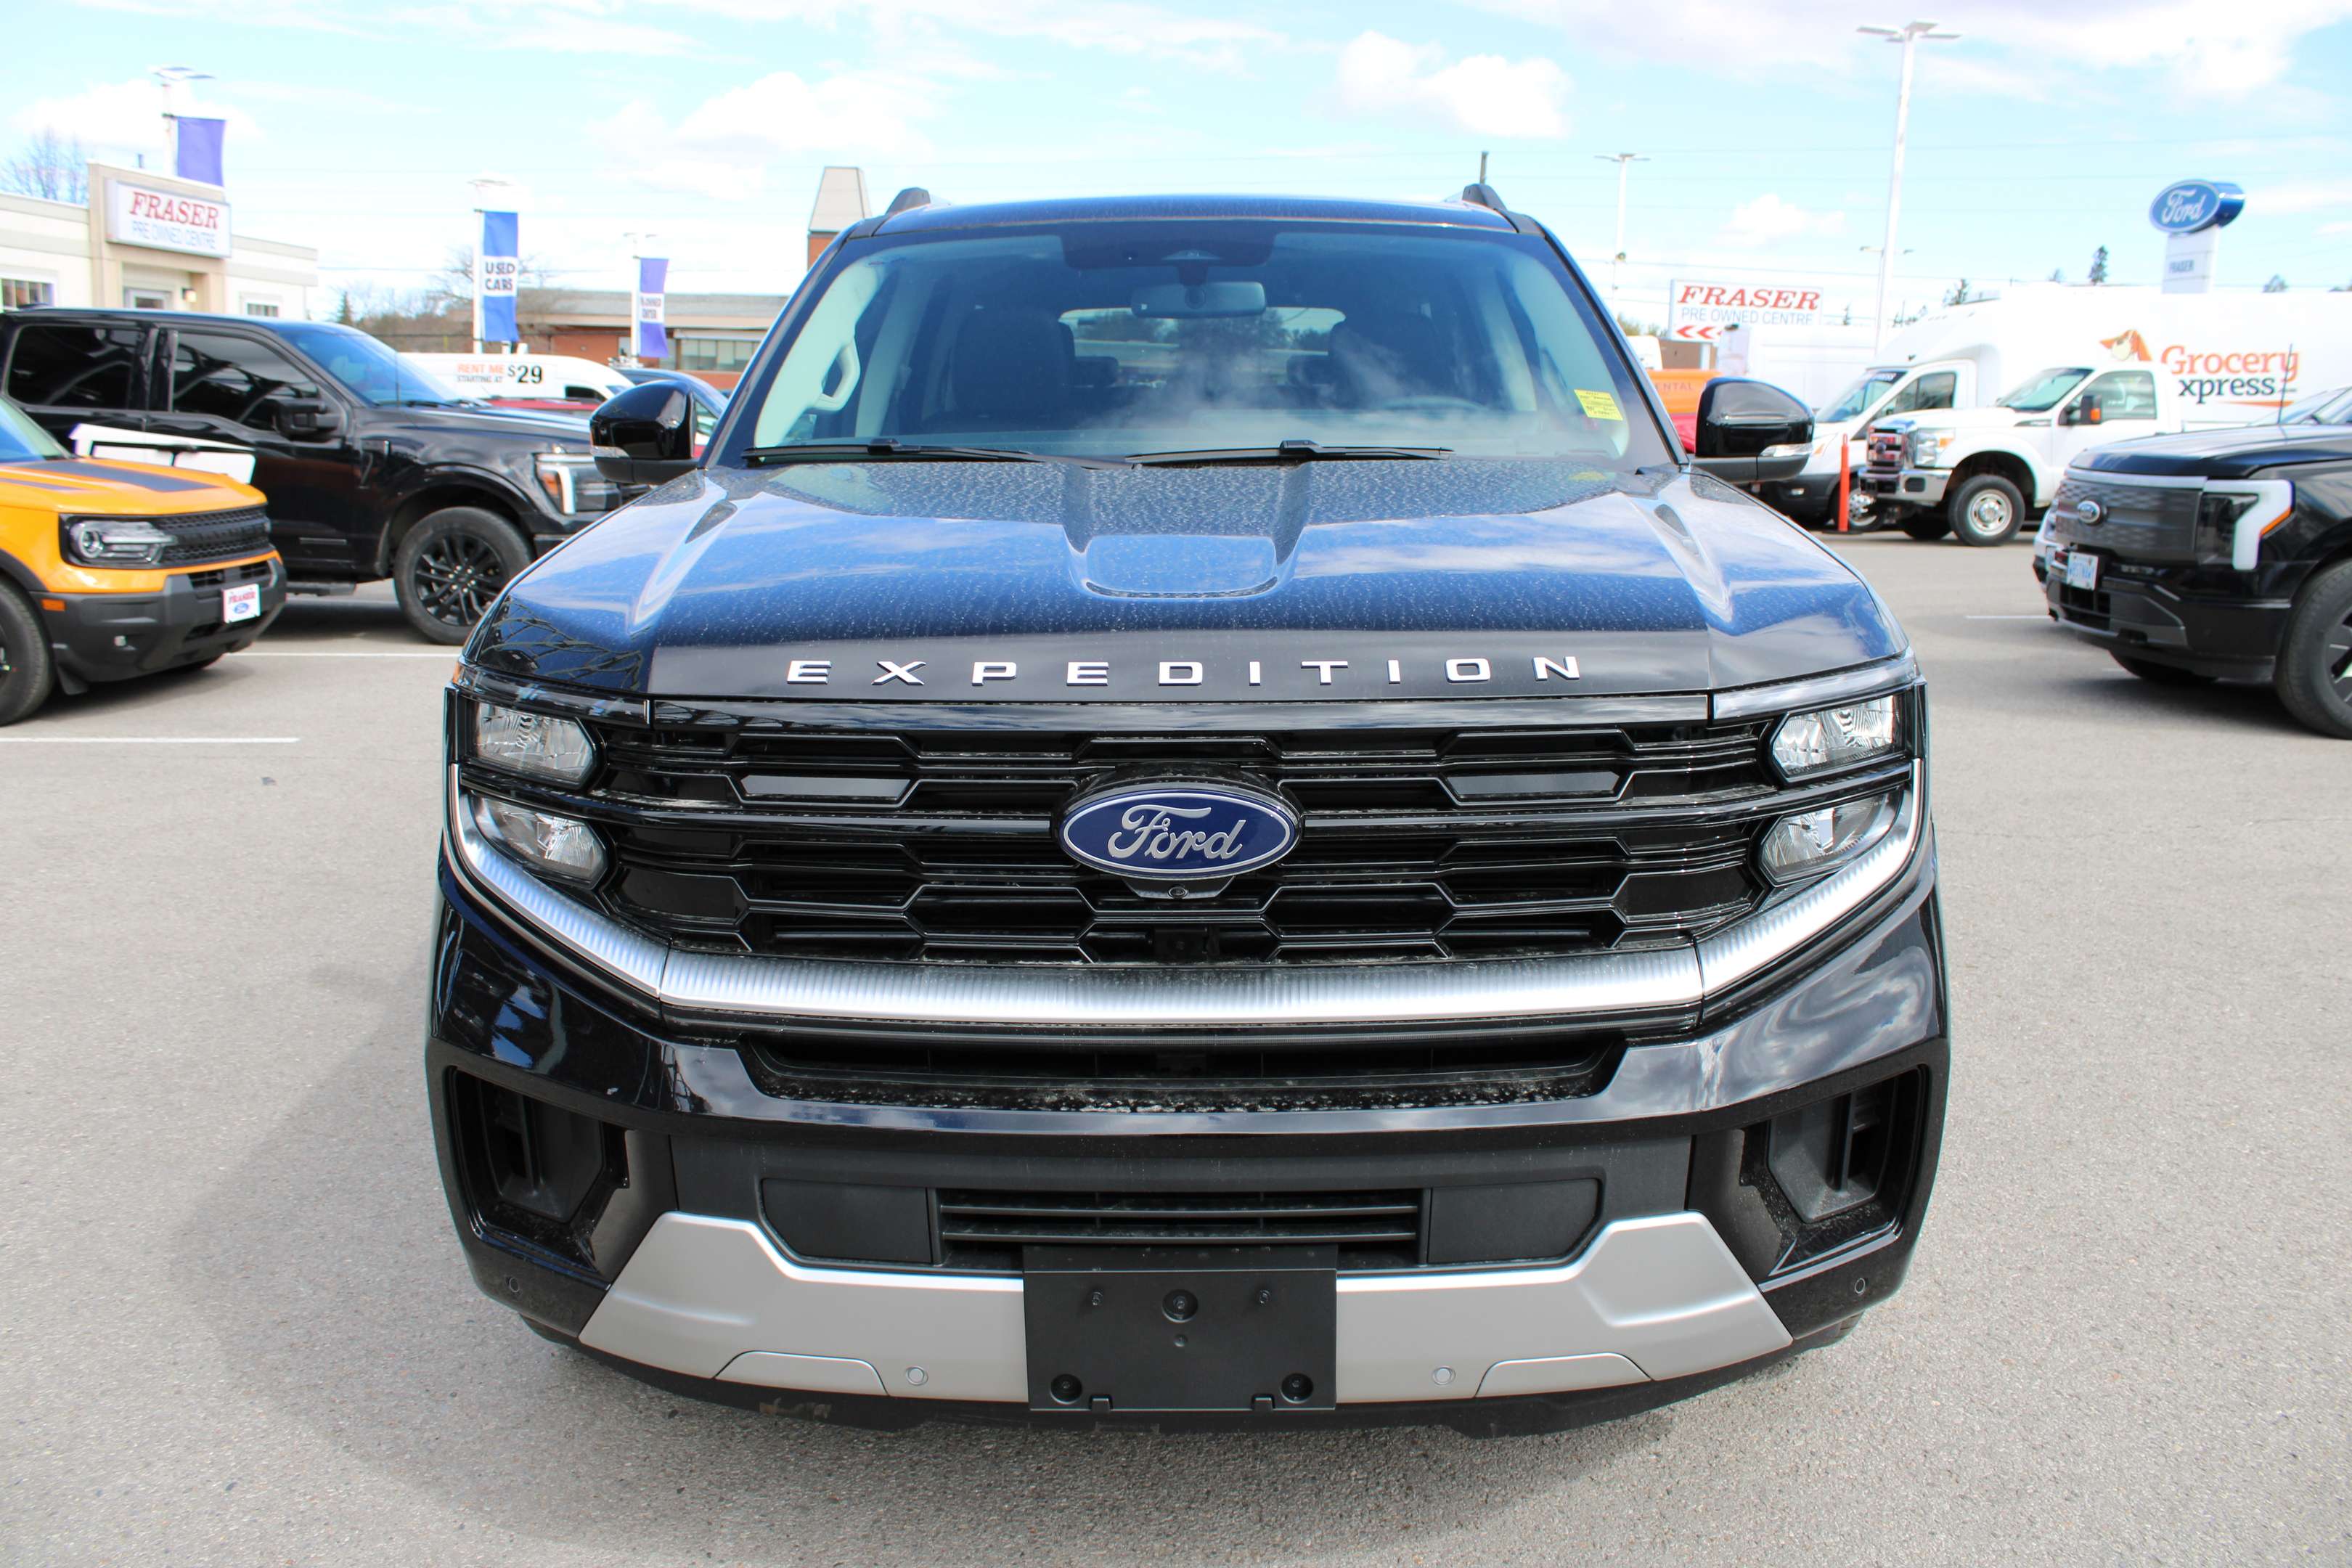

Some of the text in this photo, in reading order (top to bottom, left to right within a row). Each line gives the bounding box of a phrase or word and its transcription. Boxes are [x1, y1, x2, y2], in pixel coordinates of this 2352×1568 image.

[129, 192, 219, 229] FRASER
[2161, 188, 2207, 224] Ford
[485, 261, 515, 274] USED
[485, 277, 513, 290] CARS
[1677, 285, 1821, 311] FRASER
[1681, 306, 1813, 326] PRE OWNED CENTRE
[457, 364, 505, 373] RENT ME
[2160, 344, 2299, 383] Grocery
[2178, 377, 2276, 405] xpress
[786, 656, 1580, 687] EXPEDITION
[1107, 804, 1246, 859] Ford
